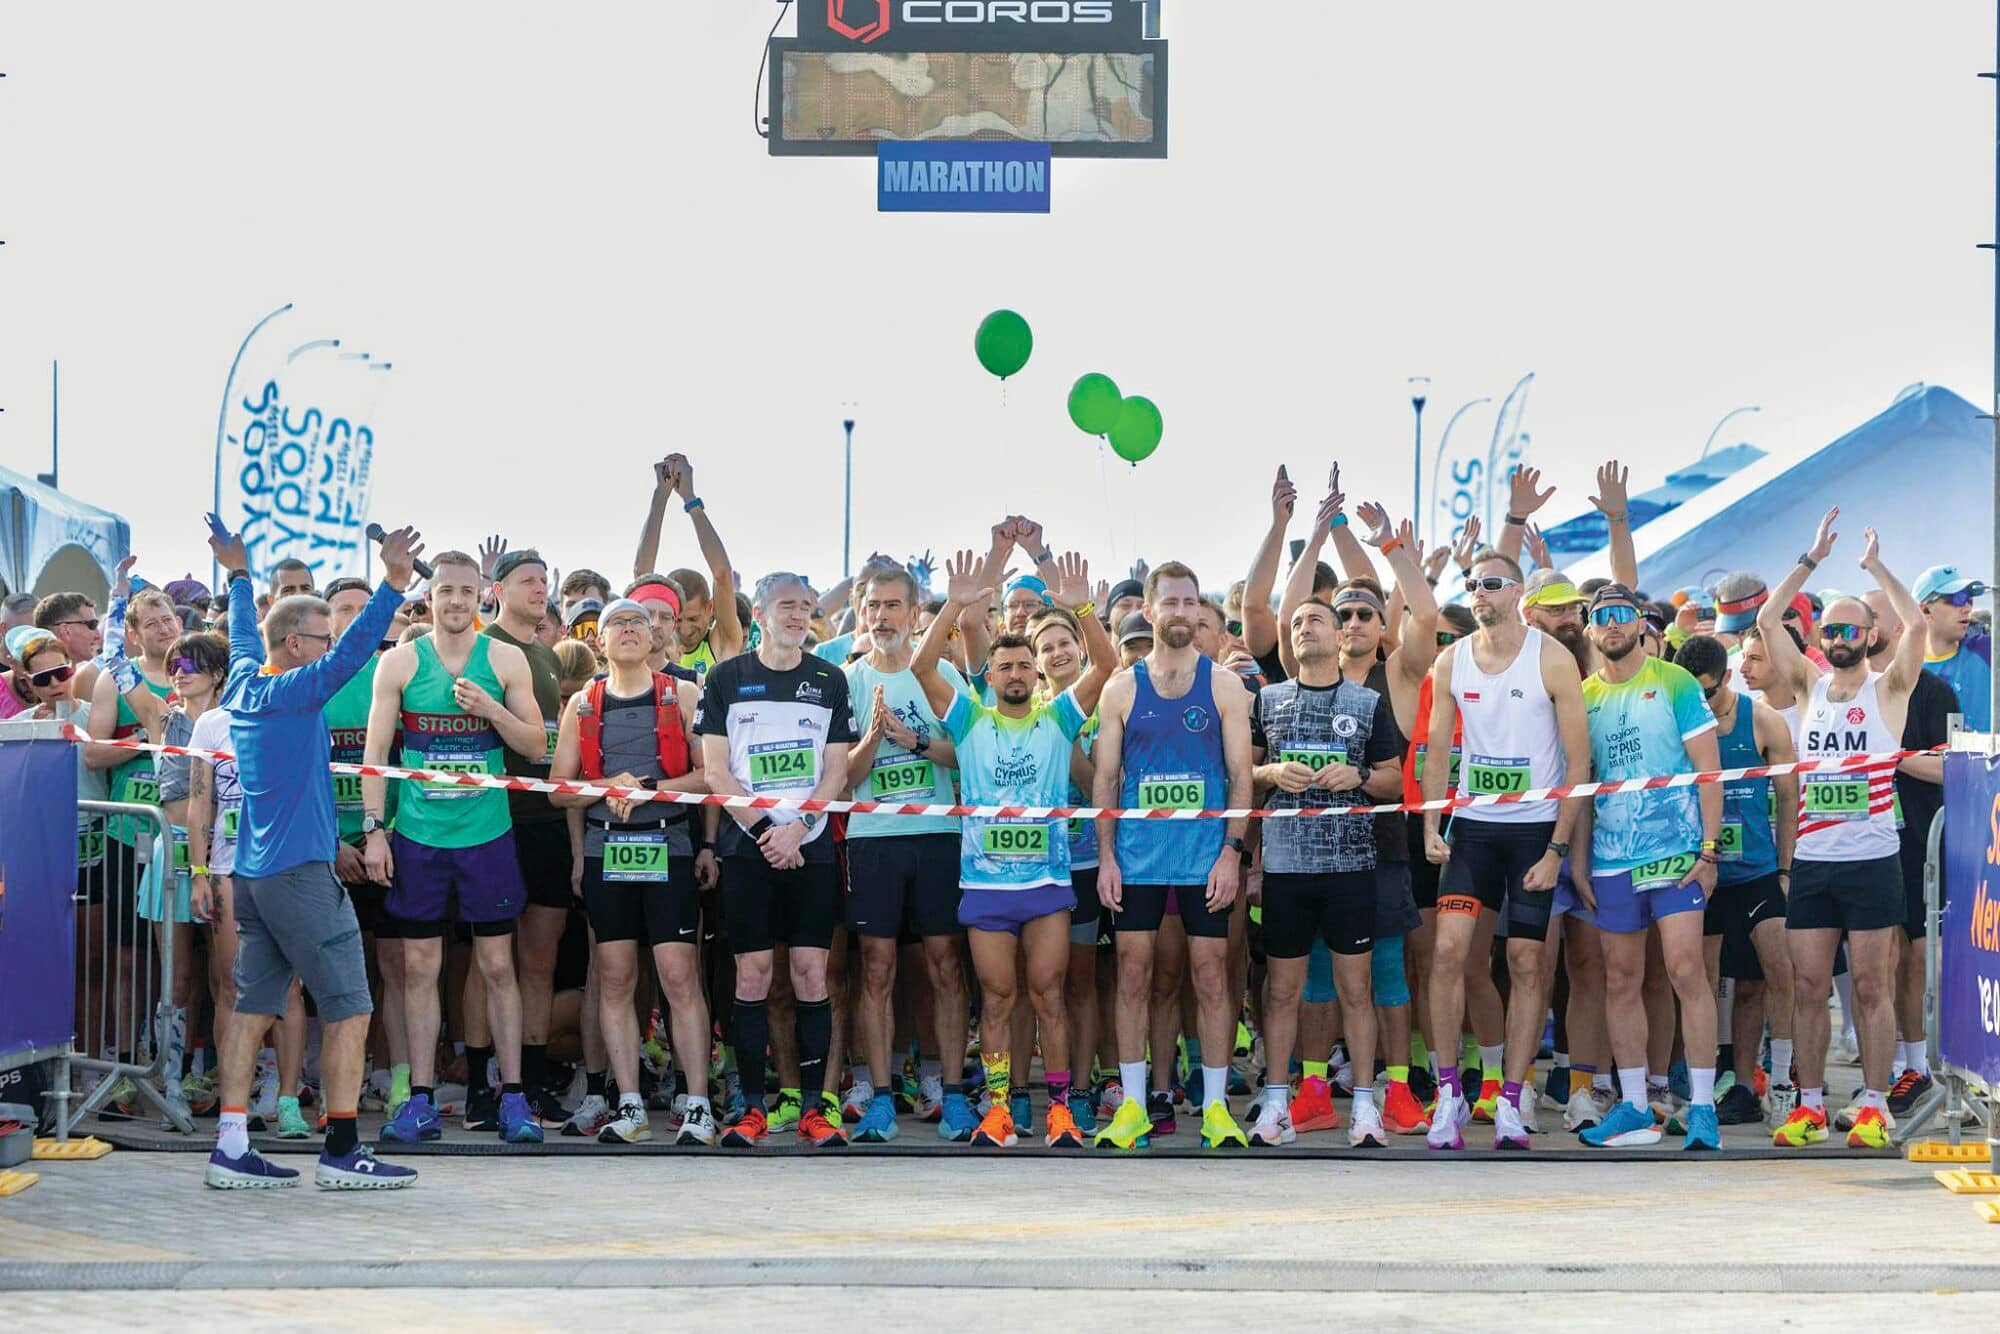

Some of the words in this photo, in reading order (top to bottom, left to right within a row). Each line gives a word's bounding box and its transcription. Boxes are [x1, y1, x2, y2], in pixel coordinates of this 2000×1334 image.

[902, 1, 1112, 23] COROS
[883, 160, 1045, 193] MARATHON
[417, 716, 489, 732] STROUD
[332, 730, 366, 745] TRO
[1807, 730, 1867, 751] SAM
[759, 752, 807, 774] 1124
[995, 764, 1037, 780] CYPRUS
[878, 766, 926, 790] 1997
[1473, 770, 1522, 791] 1807
[1144, 785, 1199, 804] 1006
[1813, 785, 1858, 804] 1015
[990, 830, 1042, 849] 1902
[610, 846, 660, 865] 1057
[1639, 856, 1686, 878] 1972
[1970, 879, 2000, 953] Nex
